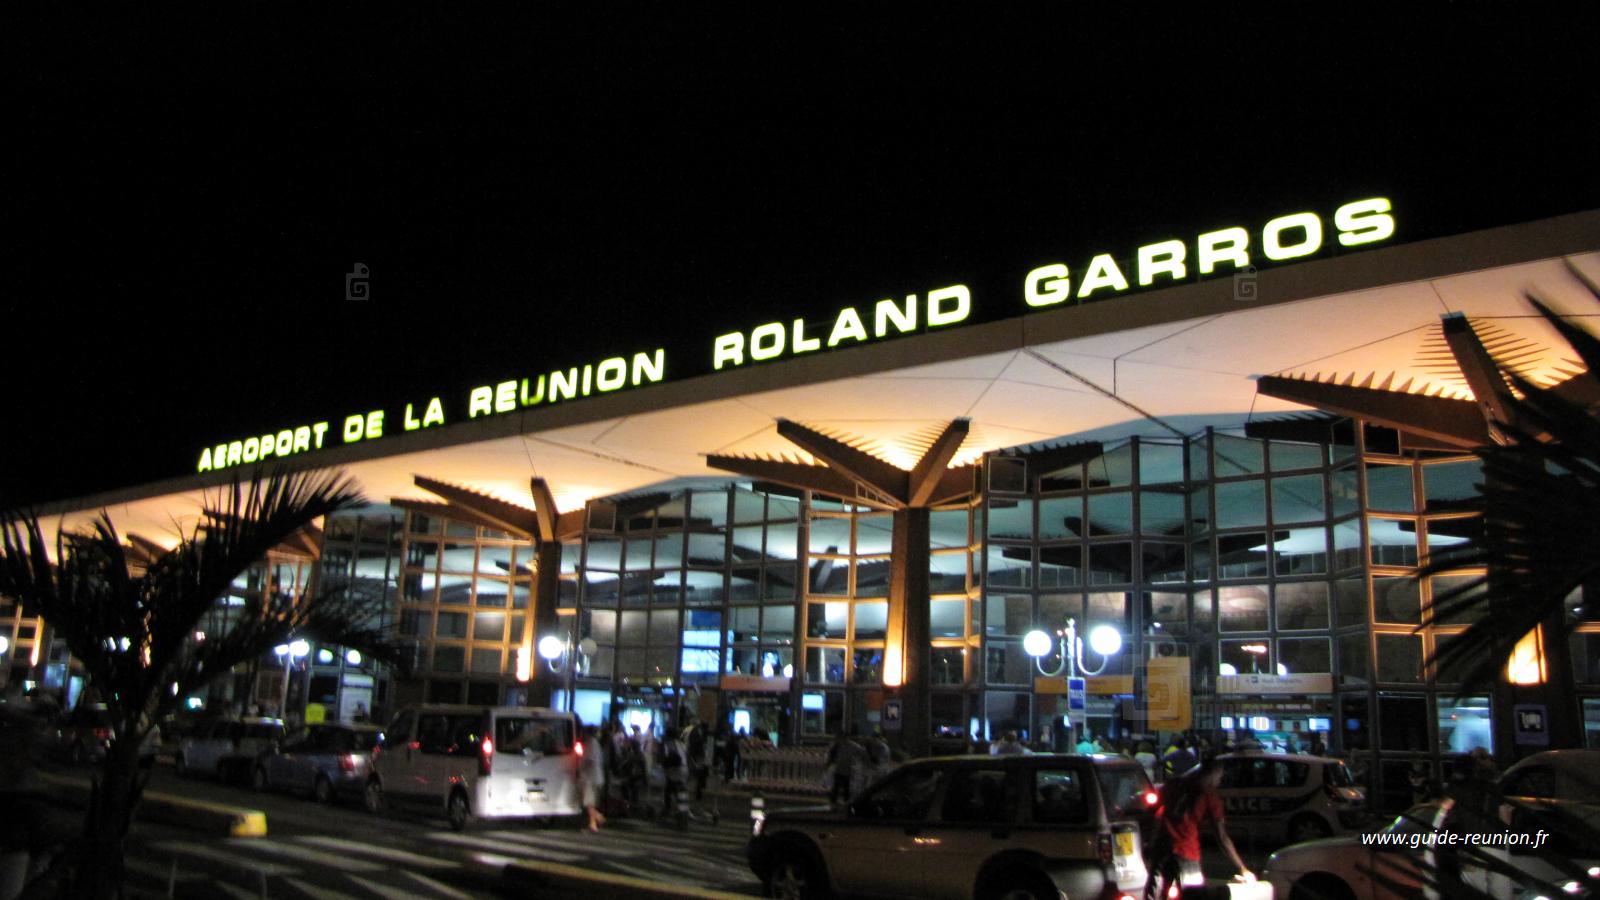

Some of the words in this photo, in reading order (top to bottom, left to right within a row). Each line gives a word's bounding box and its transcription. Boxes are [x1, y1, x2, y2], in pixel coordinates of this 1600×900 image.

[197, 420, 329, 473] AEROPORT
[343, 409, 386, 443] DE
[403, 397, 446, 432] LA
[468, 348, 666, 419] REUNION
[712, 284, 971, 370] ROLAND
[1023, 197, 1395, 308] GARROS
